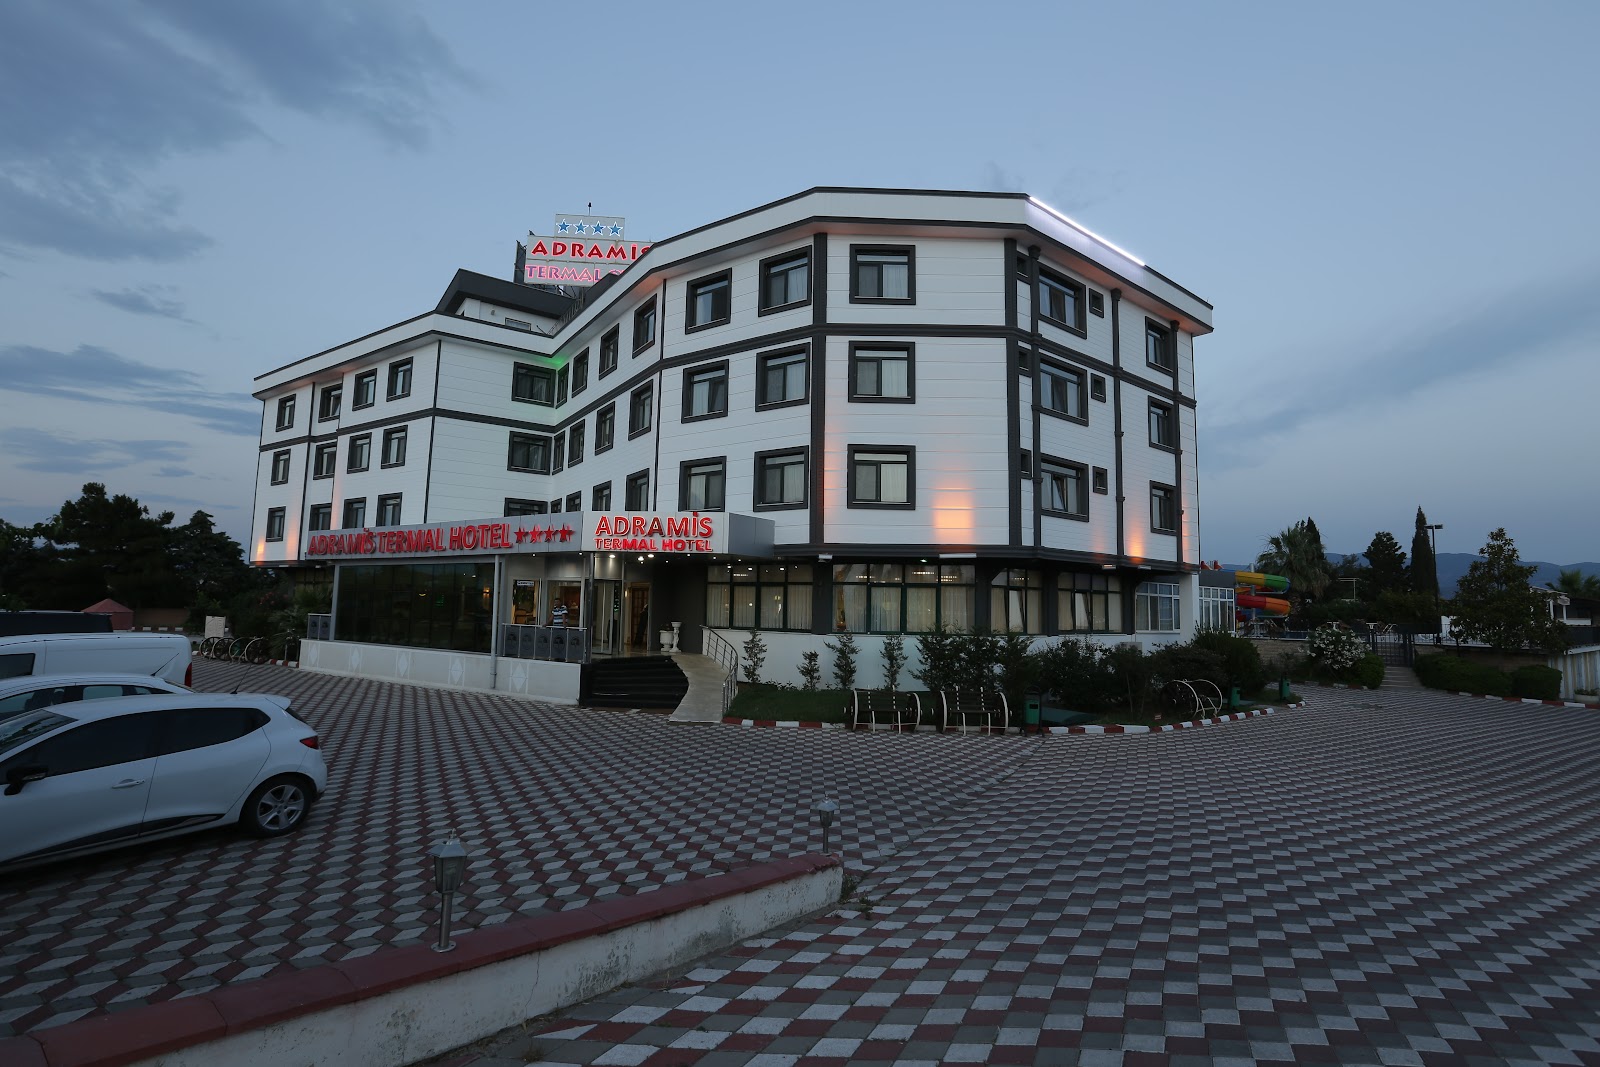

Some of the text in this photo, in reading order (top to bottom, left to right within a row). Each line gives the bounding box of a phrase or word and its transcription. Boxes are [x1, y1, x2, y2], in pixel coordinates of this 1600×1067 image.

[525, 264, 602, 283] TERMAL
[594, 511, 713, 538] ADRAMİS
[376, 526, 445, 553] TERMAL
[449, 523, 513, 550] HOTEL
[593, 537, 713, 552] TERMAL HOTEL
